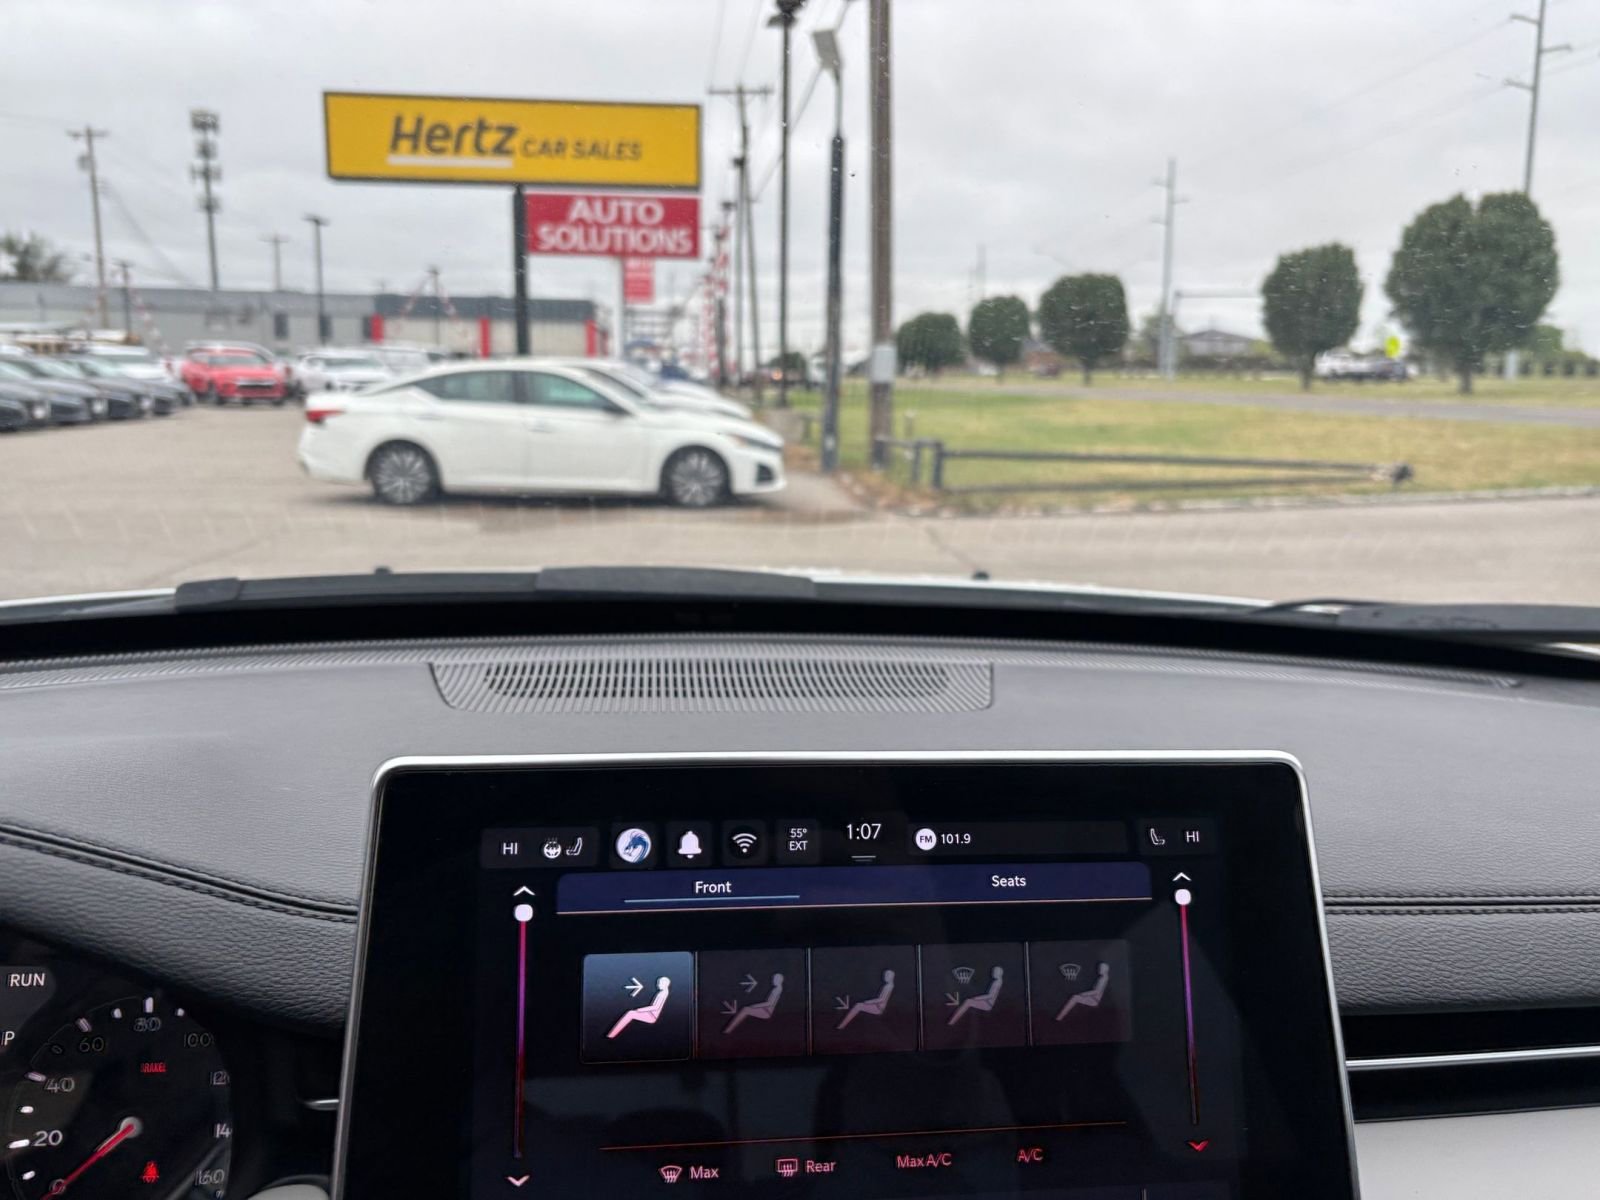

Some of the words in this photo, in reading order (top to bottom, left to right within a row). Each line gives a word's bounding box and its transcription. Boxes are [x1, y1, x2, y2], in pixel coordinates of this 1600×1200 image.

[389, 114, 518, 156] Hertz
[523, 138, 567, 159] CAR
[573, 139, 643, 162] SALES
[567, 198, 665, 226] AUTO
[536, 224, 693, 255] SOLUTIONS
[846, 823, 882, 841] 1:07
[919, 834, 934, 844] FM
[940, 833, 971, 845] 101.9
[1186, 831, 1200, 843] HI
[502, 842, 518, 855] HI
[788, 841, 808, 851] EXT
[695, 880, 731, 894] Front
[991, 874, 1027, 888] Seats
[9, 973, 46, 987] RUN
[133, 1017, 162, 1032] 80
[79, 1037, 105, 1052] 60
[45, 1077, 76, 1093] 40
[33, 1129, 64, 1146] 20
[897, 1155, 924, 1168] Max
[925, 1154, 952, 1168] A/C
[1018, 1148, 1043, 1163] A/C
[690, 1166, 719, 1179] Max
[806, 1159, 836, 1174] Rear
